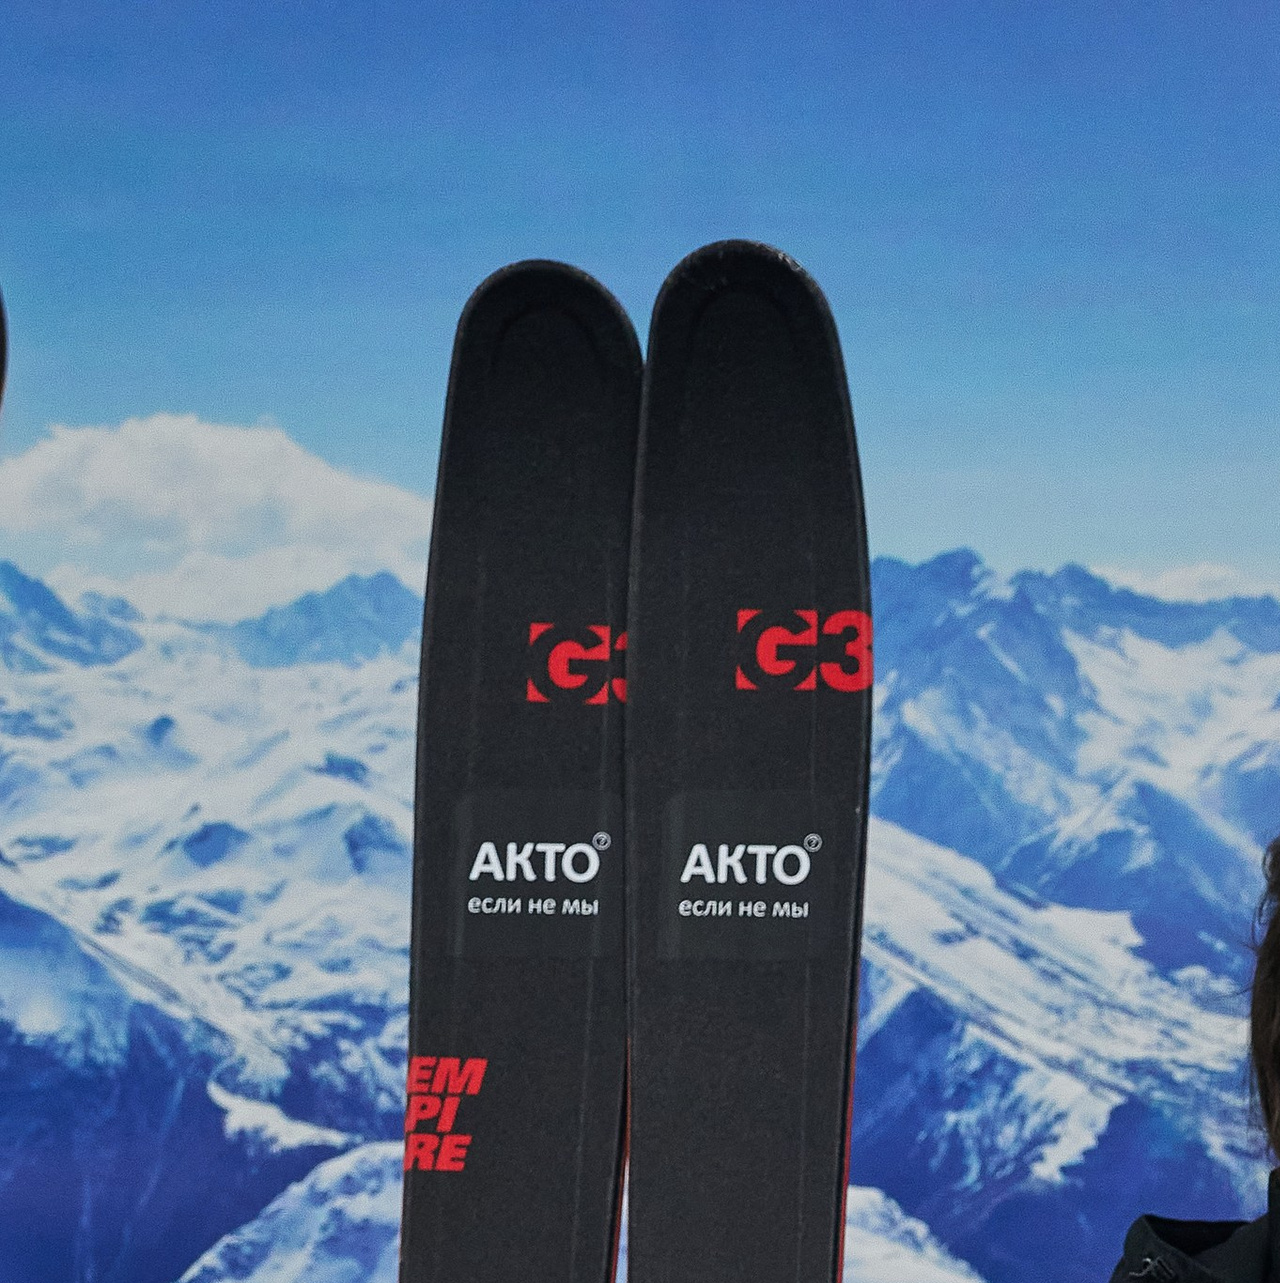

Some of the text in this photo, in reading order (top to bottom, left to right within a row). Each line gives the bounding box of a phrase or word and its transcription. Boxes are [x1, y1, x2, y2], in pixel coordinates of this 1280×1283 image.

[526, 622, 628, 705] G
[736, 609, 873, 693] G3
[469, 841, 601, 884] АКТО
[680, 843, 811, 886] АКТО
[468, 896, 599, 916] если не мы
[678, 899, 809, 918] если не мы
[406, 1056, 489, 1095] EM
[404, 1094, 461, 1133] PI
[403, 1133, 473, 1173] RE
